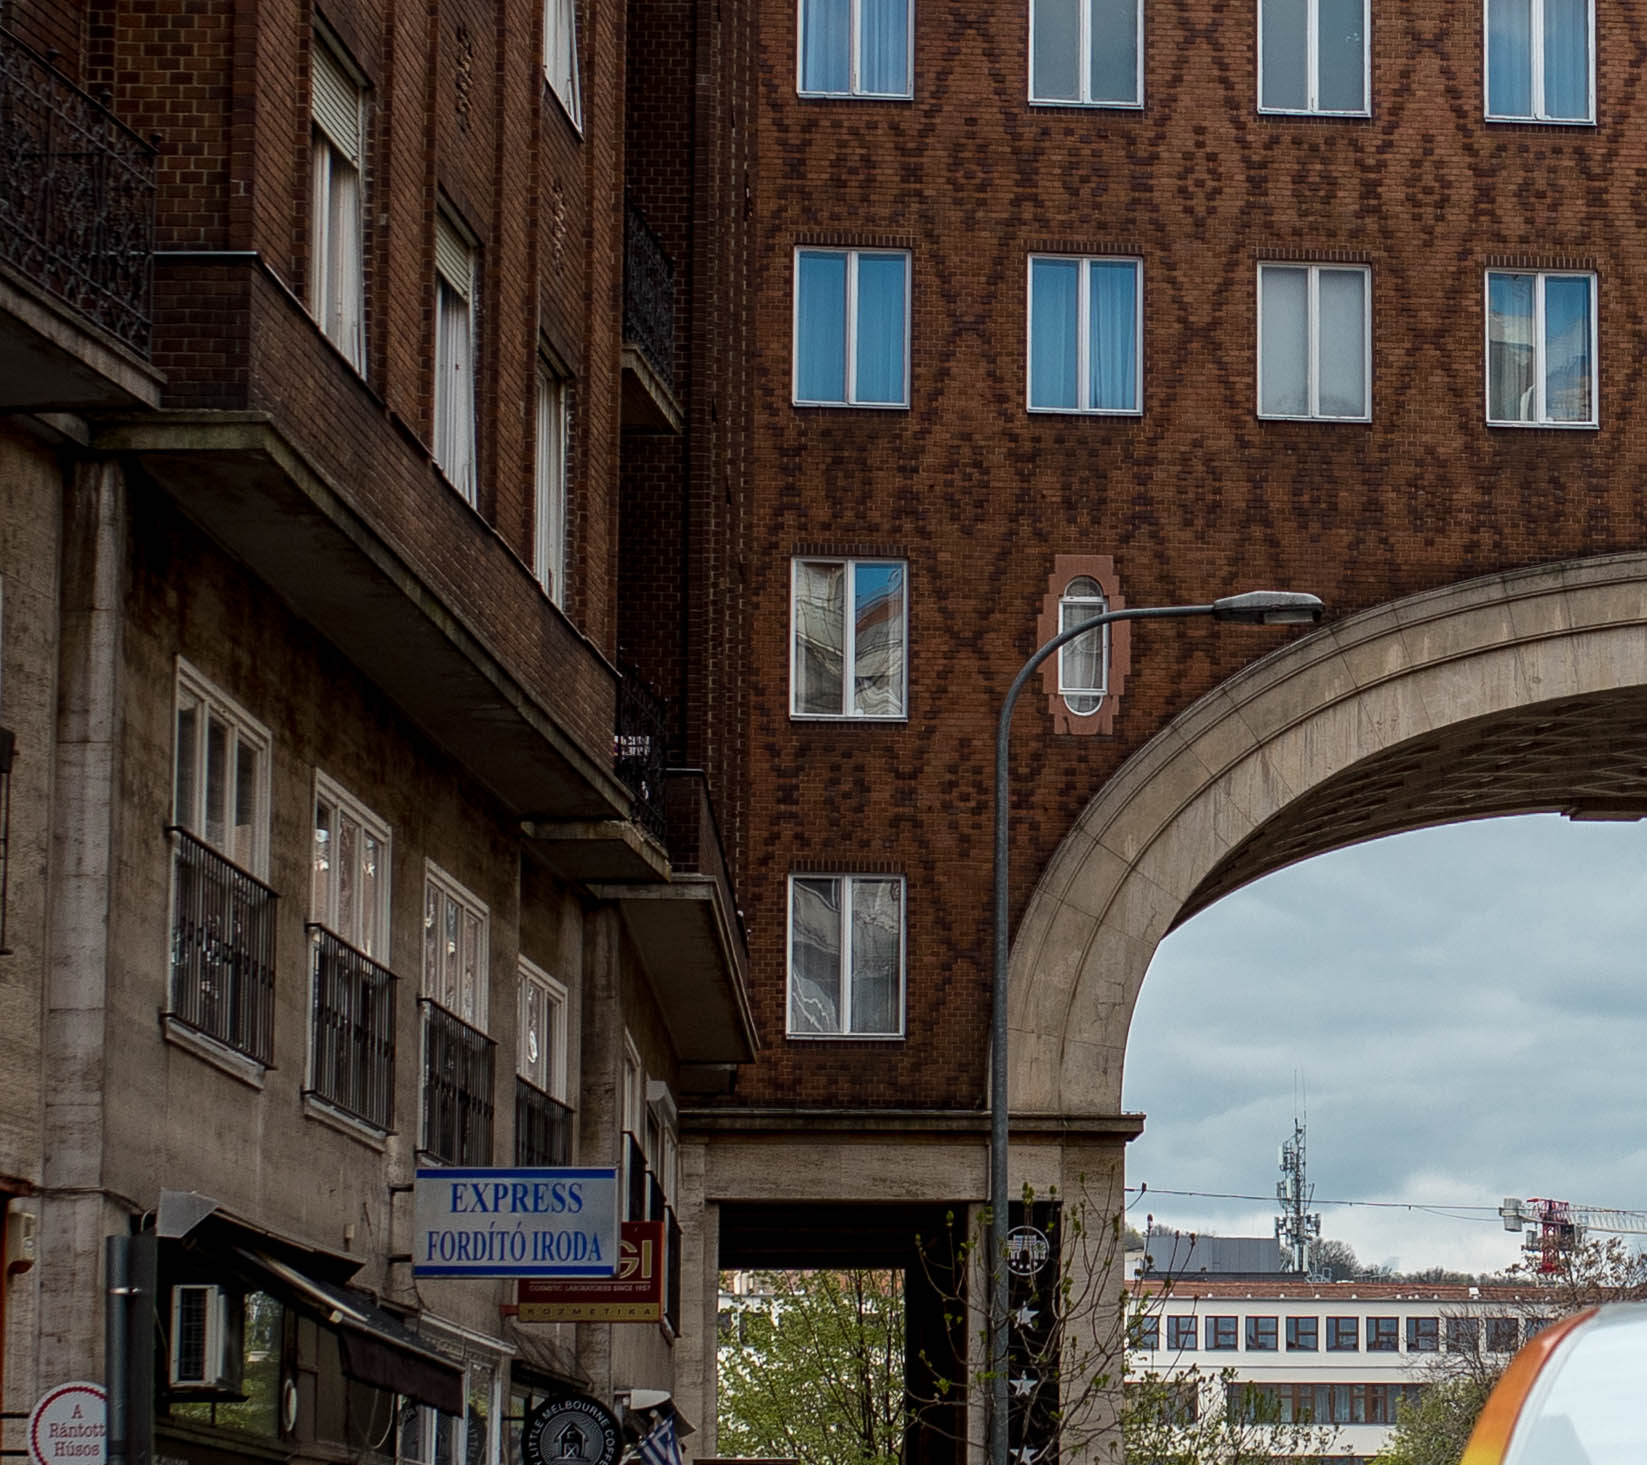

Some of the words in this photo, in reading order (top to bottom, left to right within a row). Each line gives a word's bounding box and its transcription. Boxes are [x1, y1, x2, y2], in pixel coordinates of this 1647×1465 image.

[449, 1182, 584, 1214] EXPRESS
[425, 1221, 527, 1262] FORDÍTÓ
[532, 1230, 603, 1262] IRODA
[618, 1239, 652, 1280] GI
[528, 1307, 652, 1316] KOZMETIKA
[71, 1405, 83, 1419] A
[54, 1440, 100, 1457] Húsos
